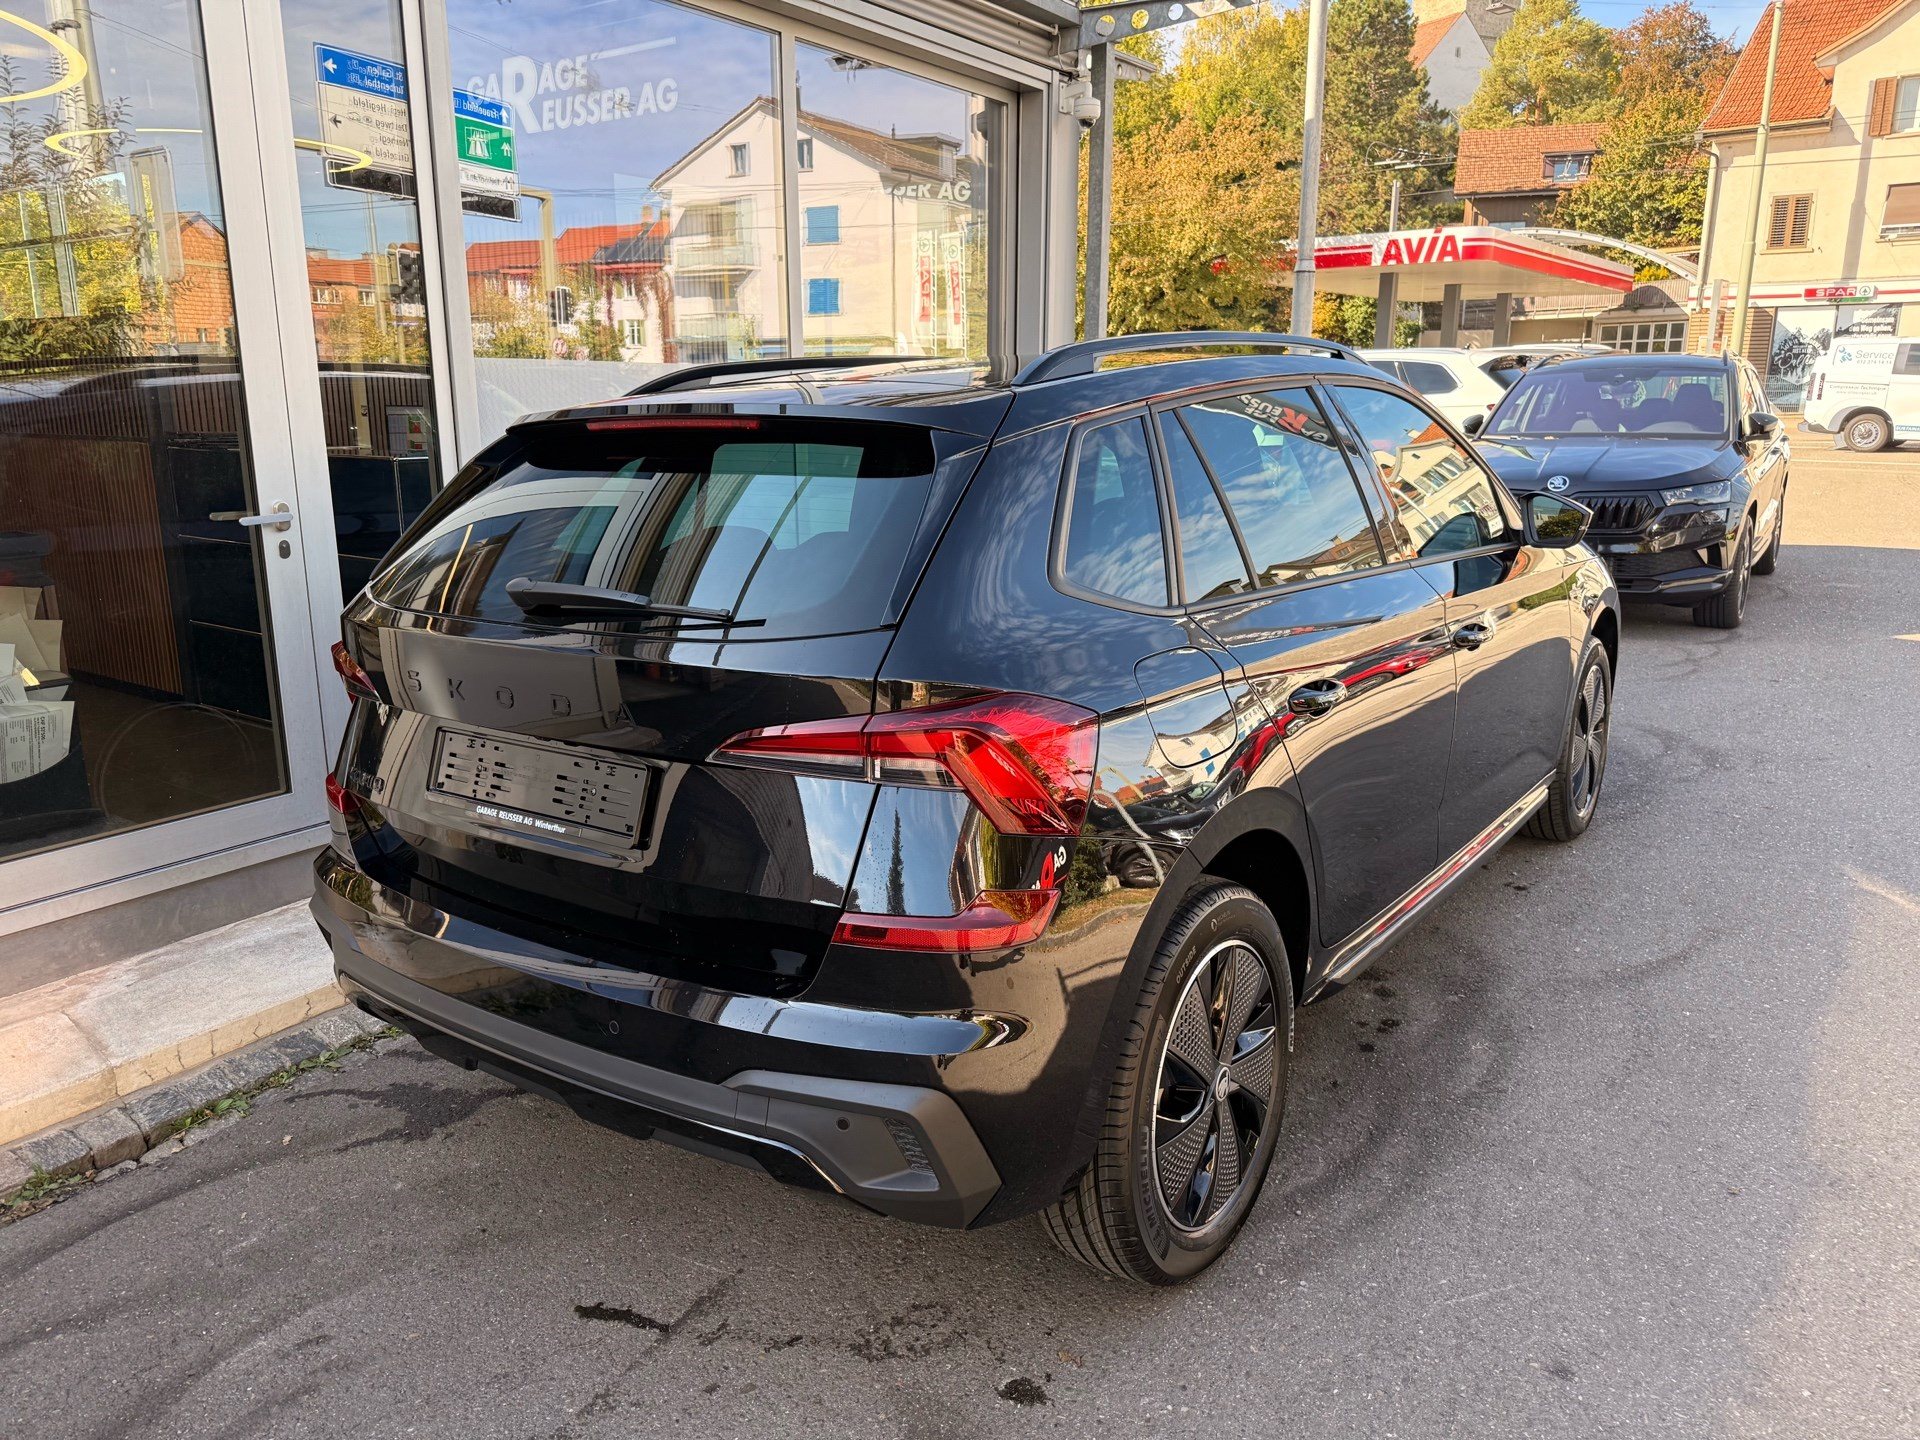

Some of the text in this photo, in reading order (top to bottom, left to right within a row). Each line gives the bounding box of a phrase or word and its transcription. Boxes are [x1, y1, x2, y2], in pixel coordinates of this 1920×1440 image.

[636, 78, 679, 117] AG
[1380, 225, 1461, 266] AVIA
[1815, 287, 1856, 298] SPAR
[1855, 350, 1894, 360] Service
[476, 805, 567, 834] GARAGE REUSSER AG Winterthur
